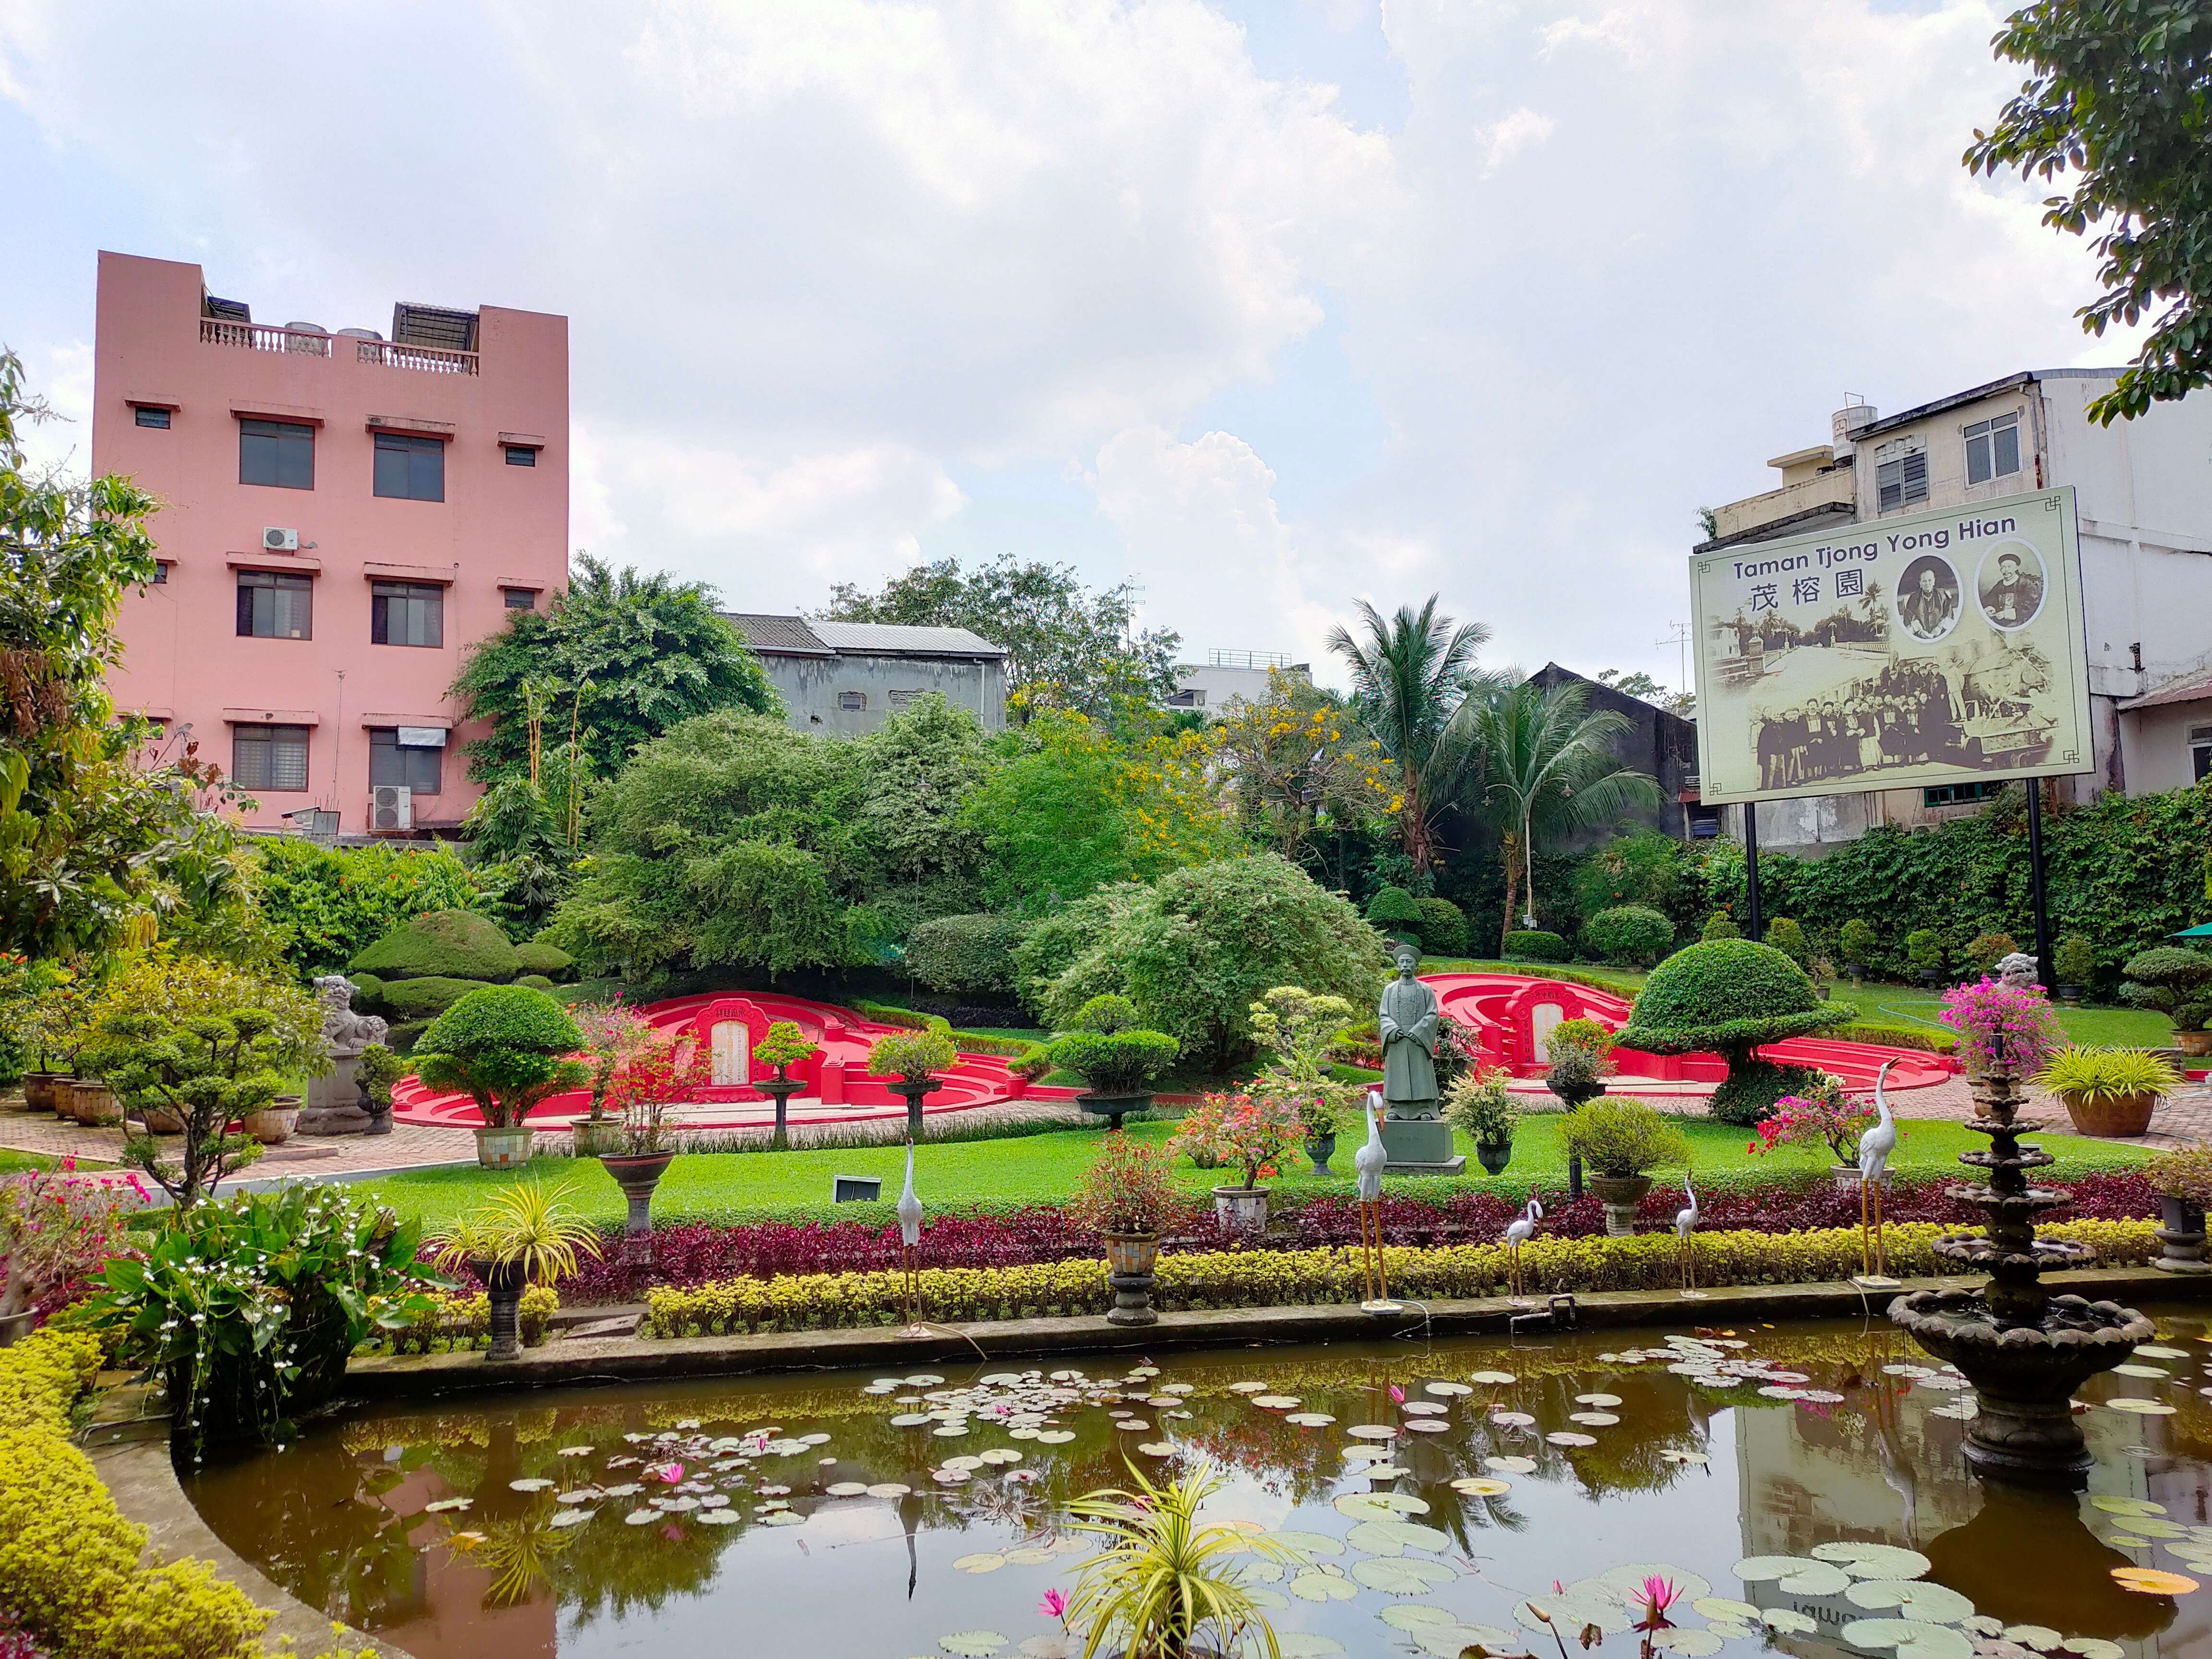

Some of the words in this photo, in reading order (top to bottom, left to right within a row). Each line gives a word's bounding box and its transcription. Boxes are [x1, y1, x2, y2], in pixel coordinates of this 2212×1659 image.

[1733, 555, 1809, 579] Taman
[1815, 542, 1878, 569] Tjong
[1886, 529, 1949, 553] Yong
[1959, 517, 2016, 541] Hian
[1750, 568, 1864, 612] 茂榕園
